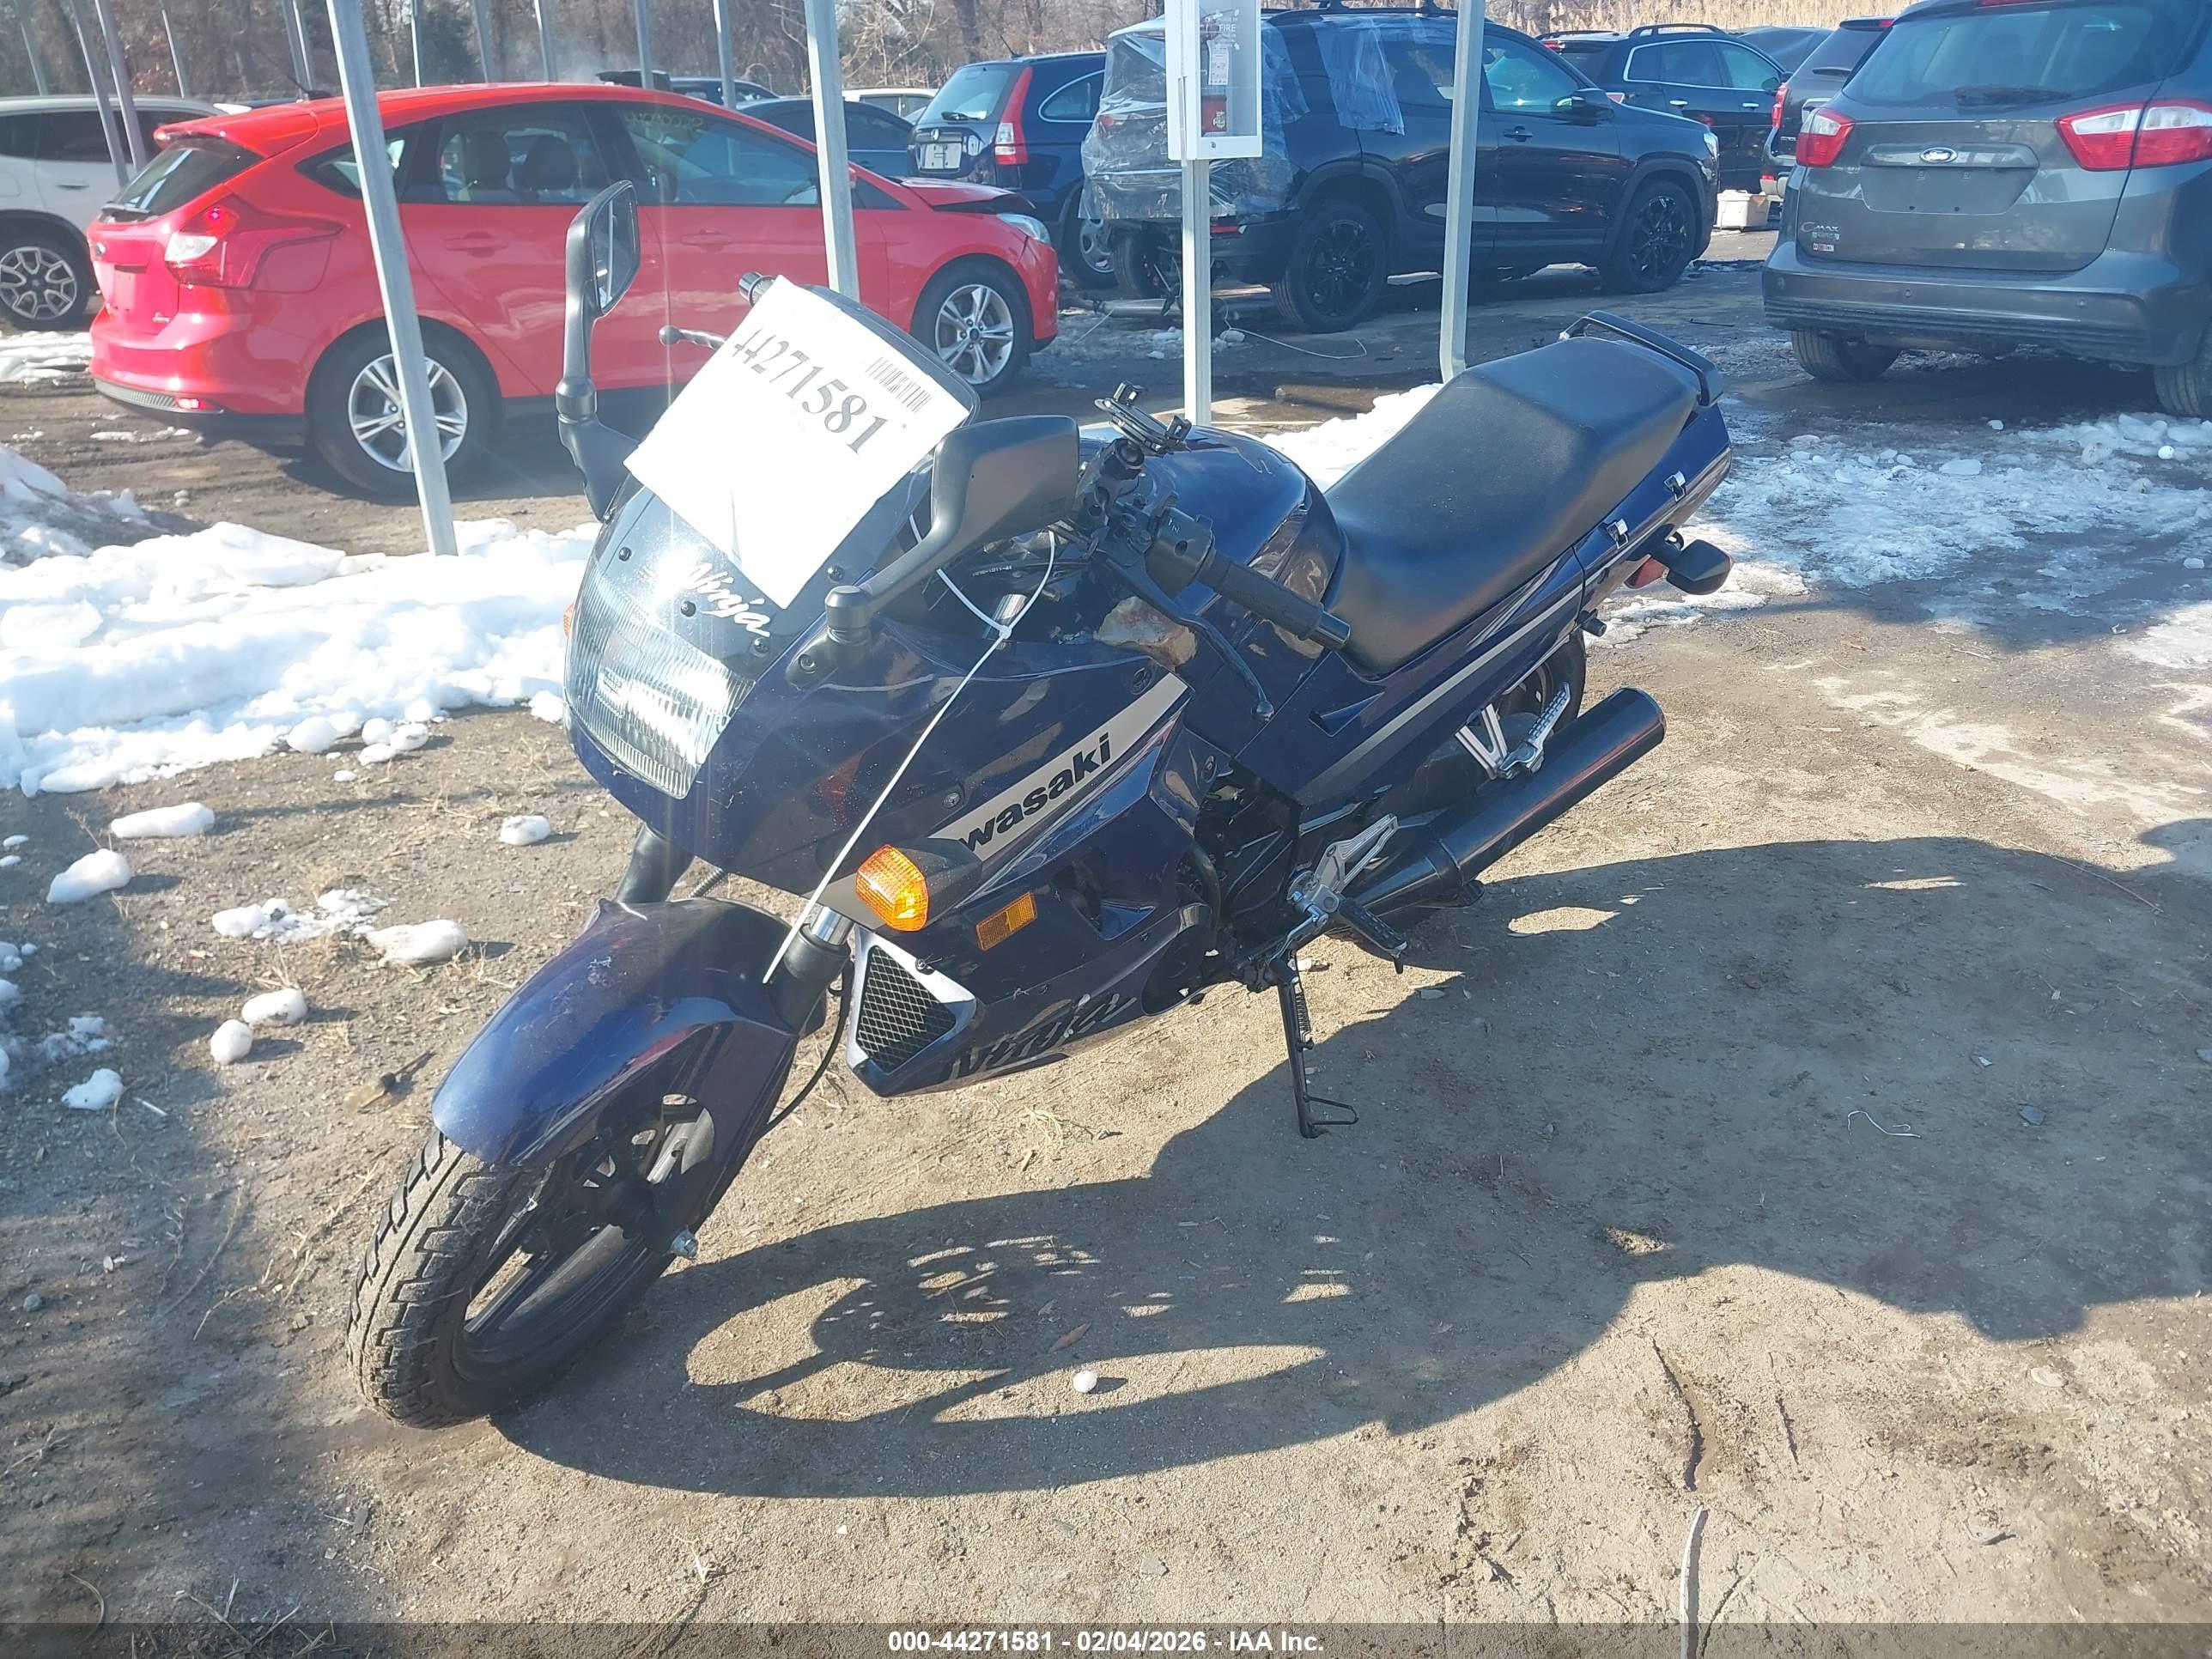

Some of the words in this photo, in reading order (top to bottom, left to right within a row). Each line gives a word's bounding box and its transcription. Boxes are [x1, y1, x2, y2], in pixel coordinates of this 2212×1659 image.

[1218, 23, 1237, 33] FIRE
[732, 328, 888, 455] 44271581
[684, 562, 771, 637] Ninja
